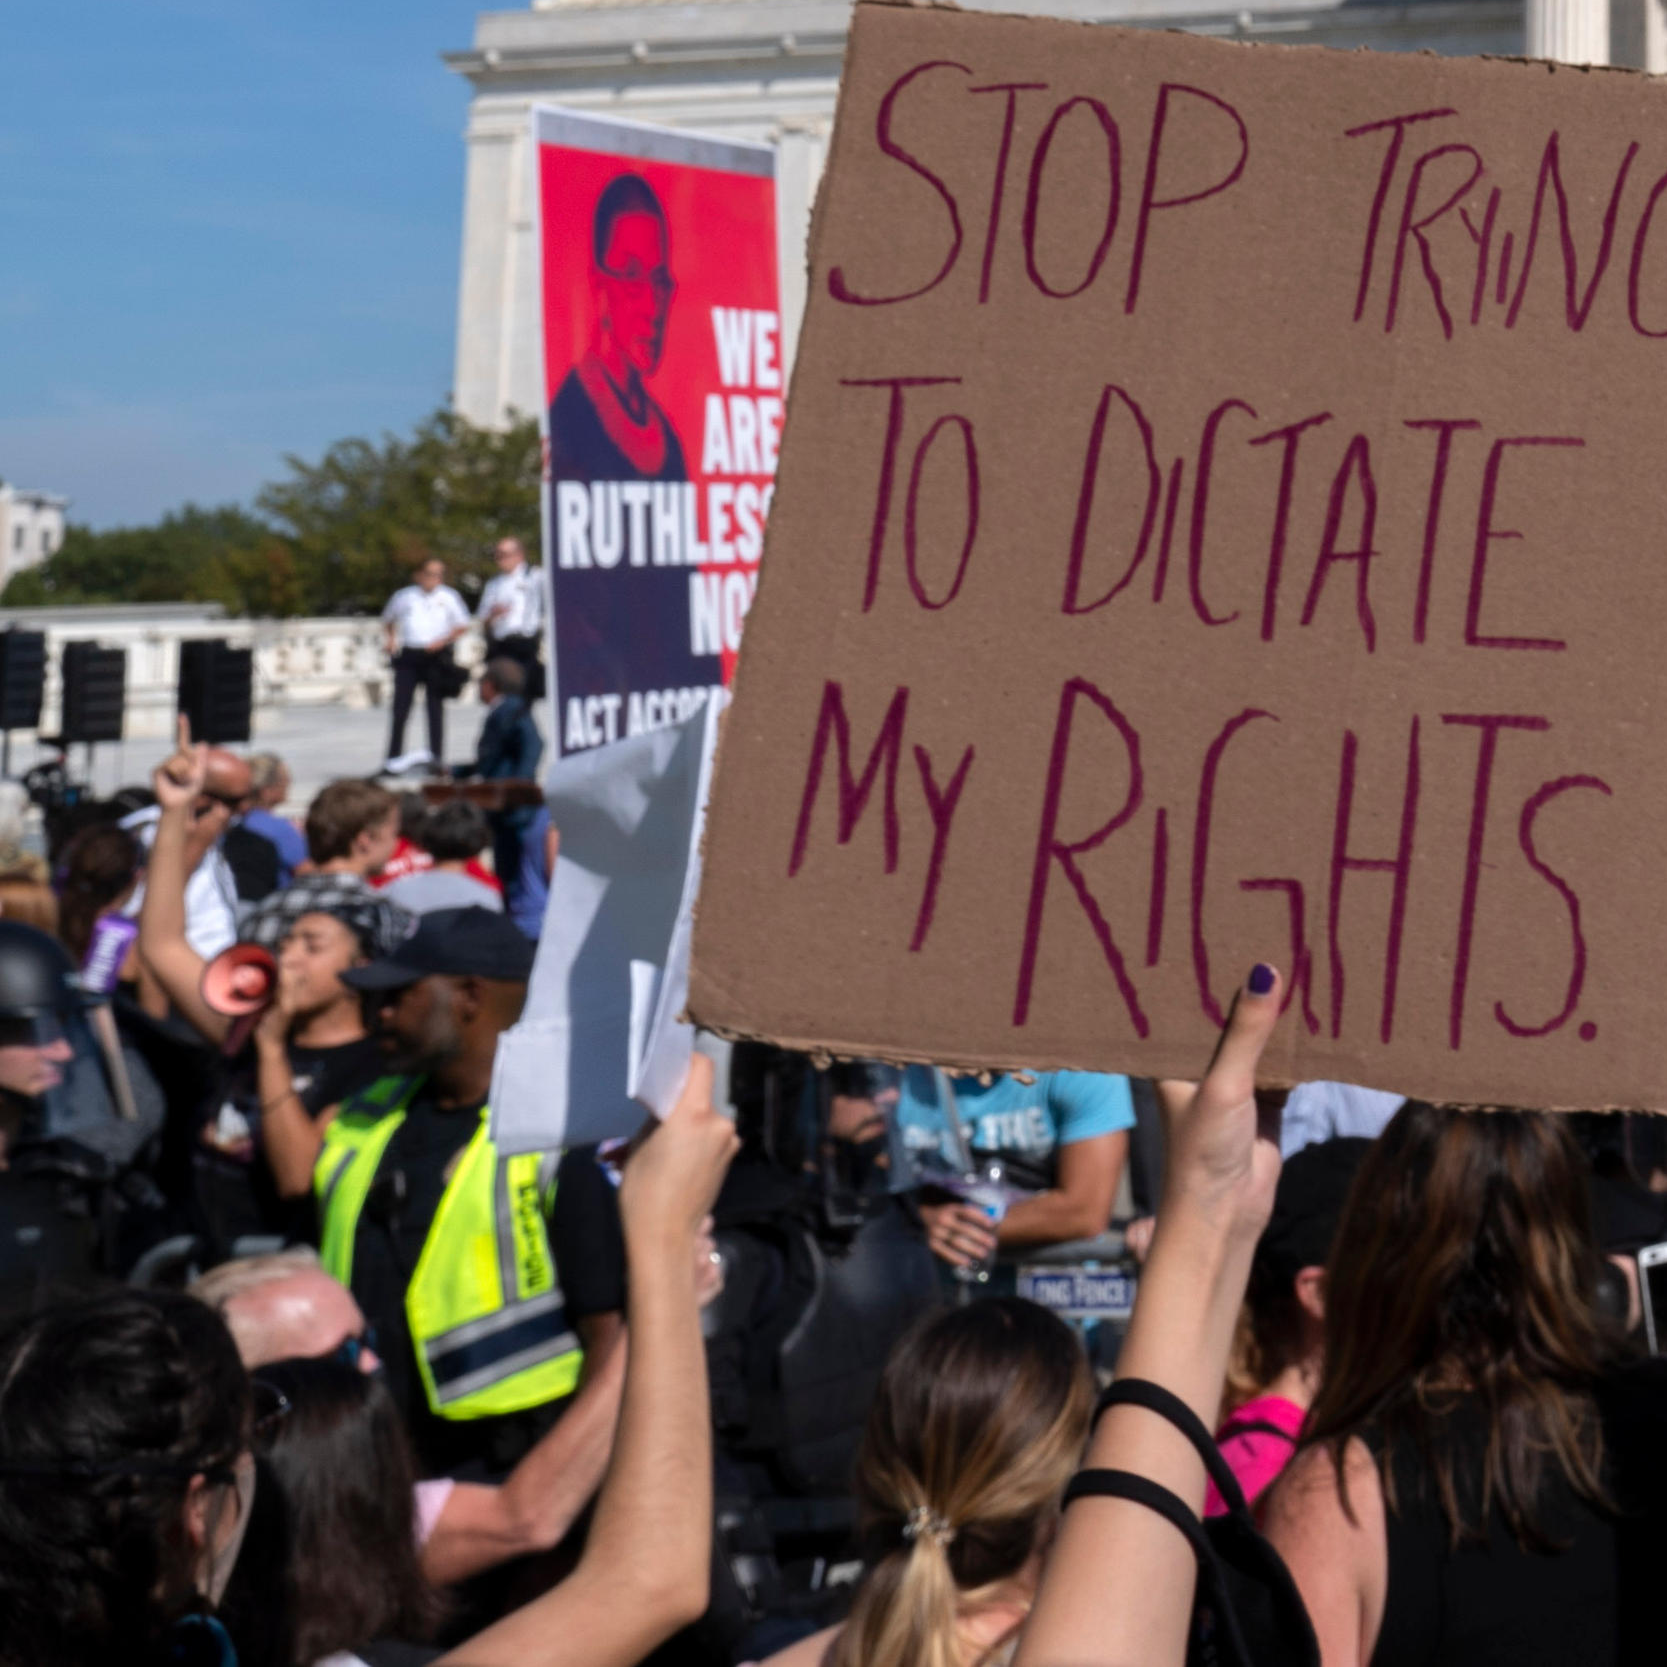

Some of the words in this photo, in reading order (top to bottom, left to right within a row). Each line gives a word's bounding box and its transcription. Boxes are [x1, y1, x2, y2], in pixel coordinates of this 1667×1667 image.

[828, 61, 1248, 315] STOP
[711, 306, 782, 390] WE
[701, 391, 783, 475] ARE
[840, 377, 980, 613] TO
[1061, 383, 1586, 654] DICTATE
[689, 571, 758, 657] NO
[565, 693, 623, 750] ACT
[787, 681, 974, 952] MY
[1012, 676, 1612, 1051] RIGHTS.
